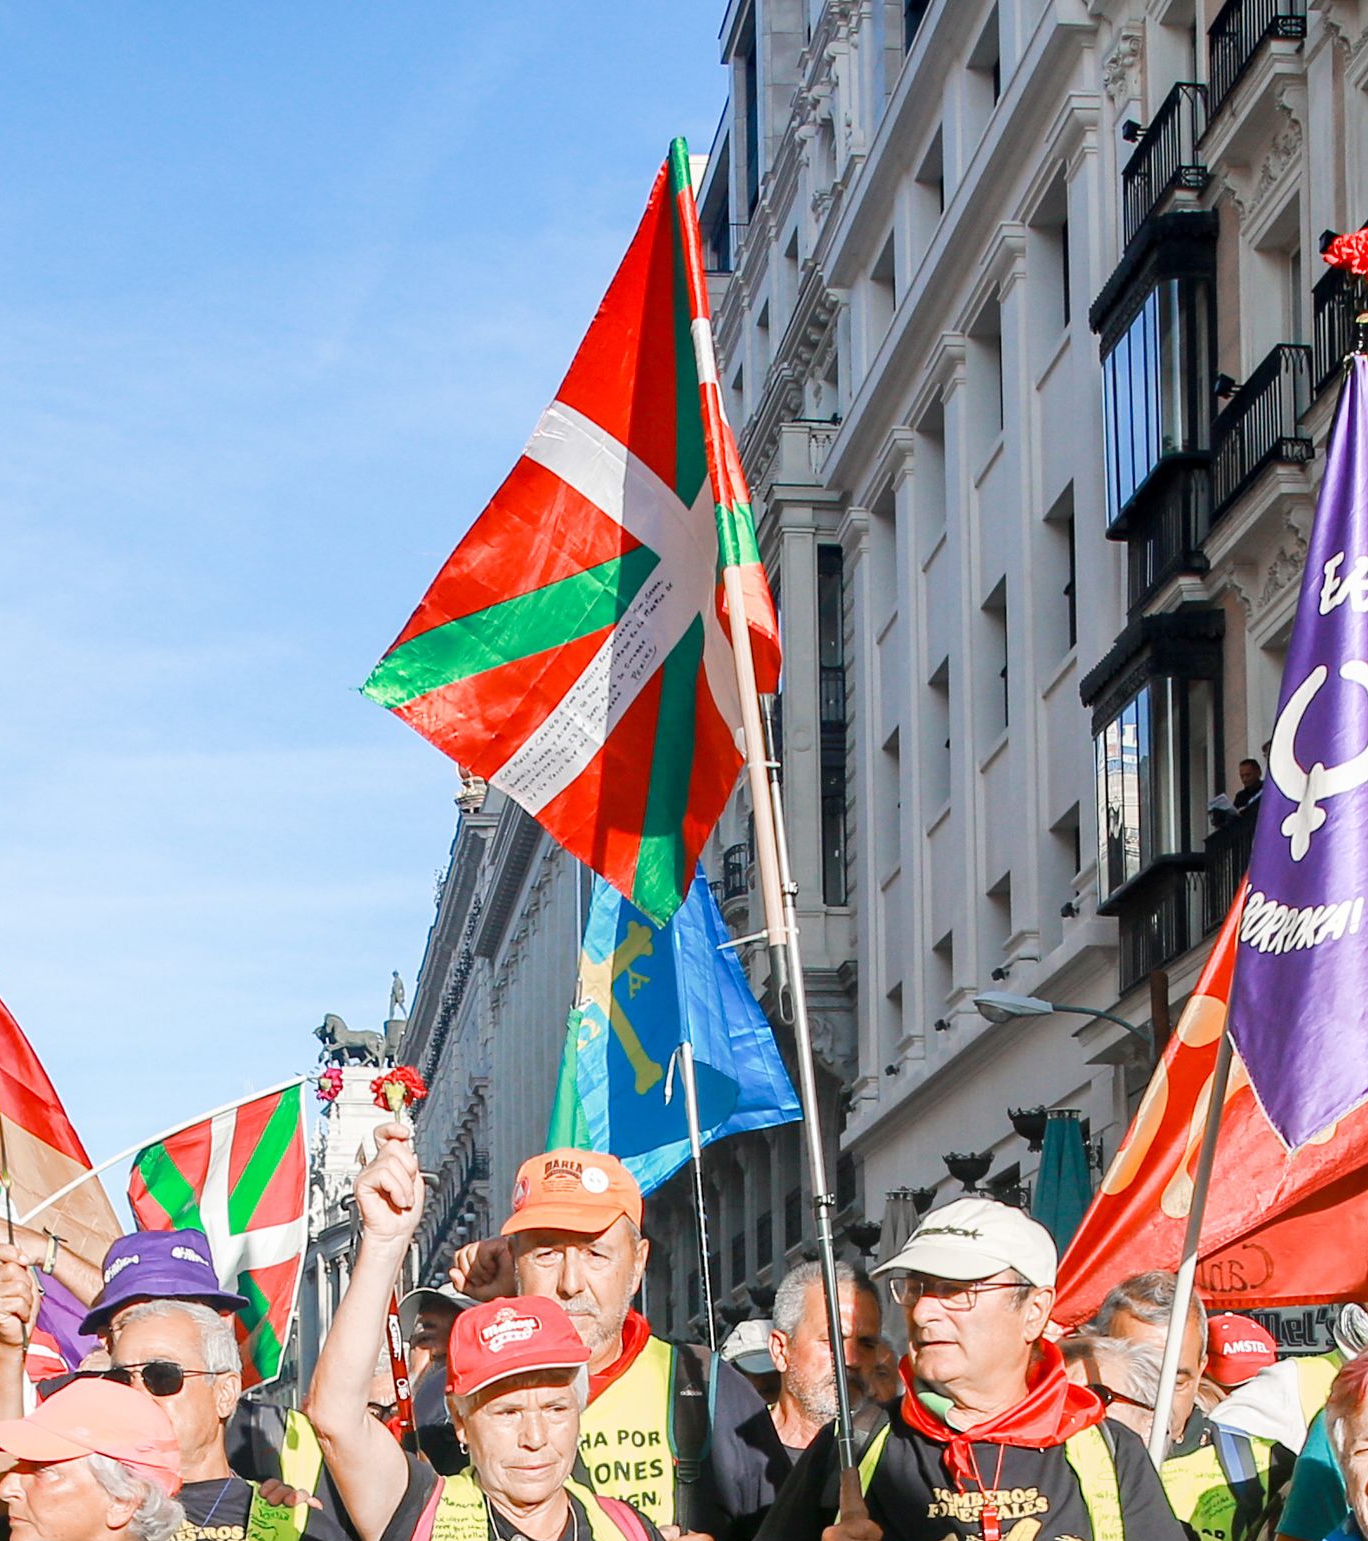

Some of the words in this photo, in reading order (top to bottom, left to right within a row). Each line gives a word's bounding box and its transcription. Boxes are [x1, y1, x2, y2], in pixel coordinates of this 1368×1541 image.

[1223, 1339, 1271, 1356] AMSTEL
[617, 1429, 662, 1448] POR
[926, 1496, 1049, 1524] FORESALES
